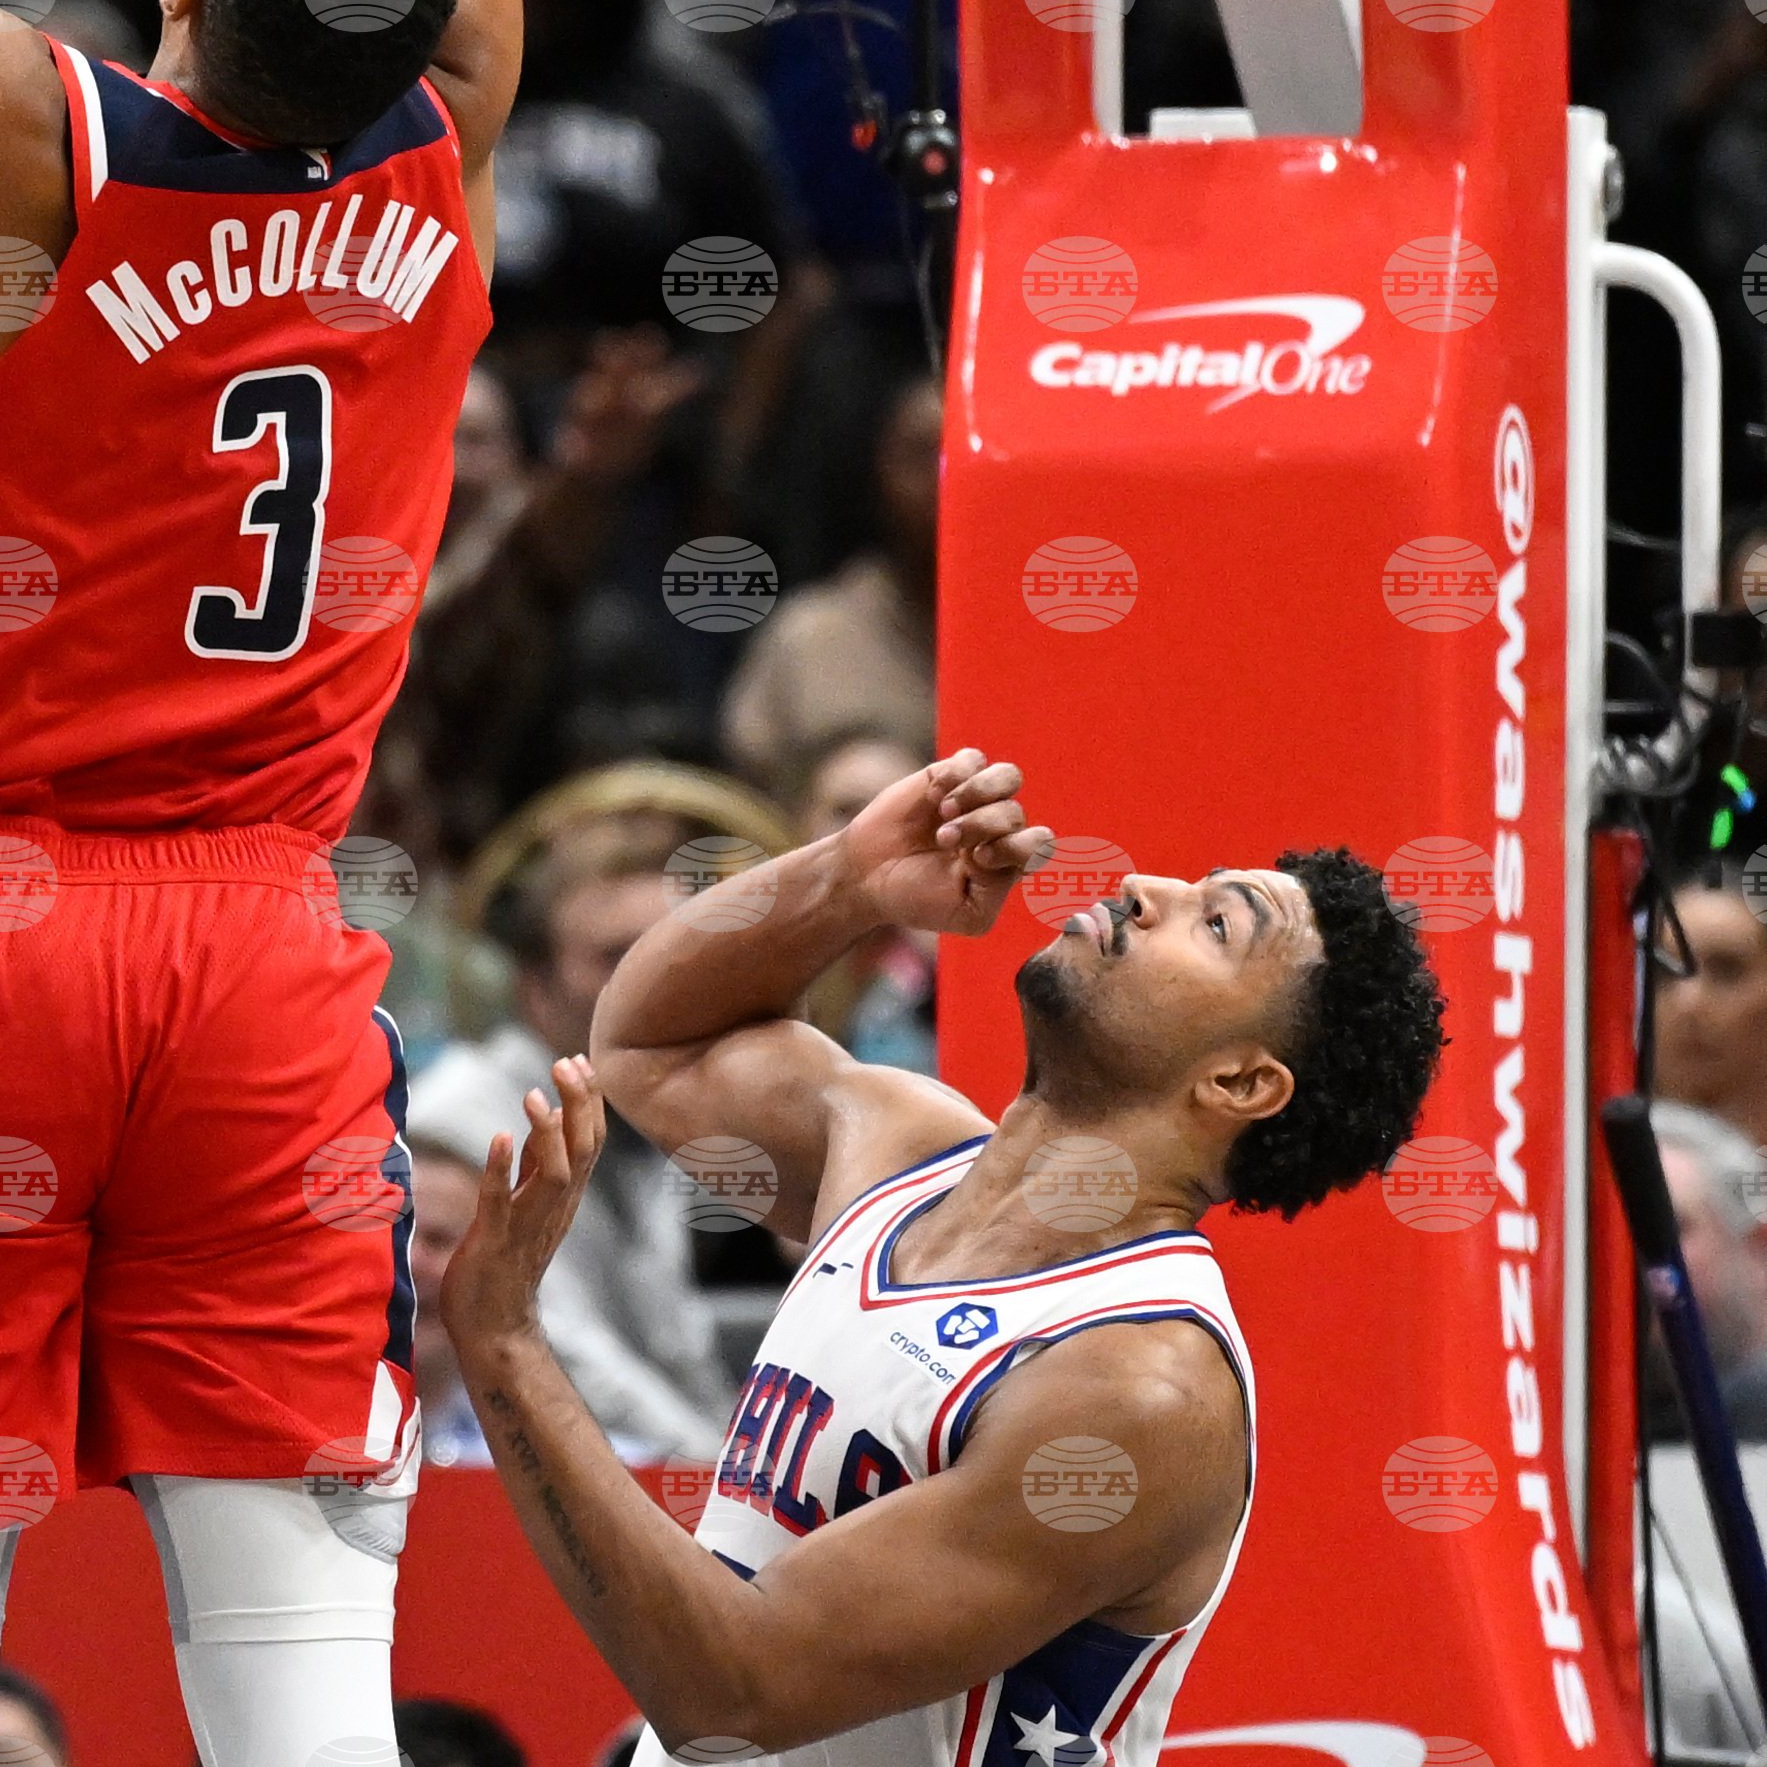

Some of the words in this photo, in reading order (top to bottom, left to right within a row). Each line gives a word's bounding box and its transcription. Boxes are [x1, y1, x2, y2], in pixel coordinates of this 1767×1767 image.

[85, 193, 460, 366] McCOLLUM
[184, 363, 333, 663] 3
[1492, 403, 1596, 1751] @washwizards
